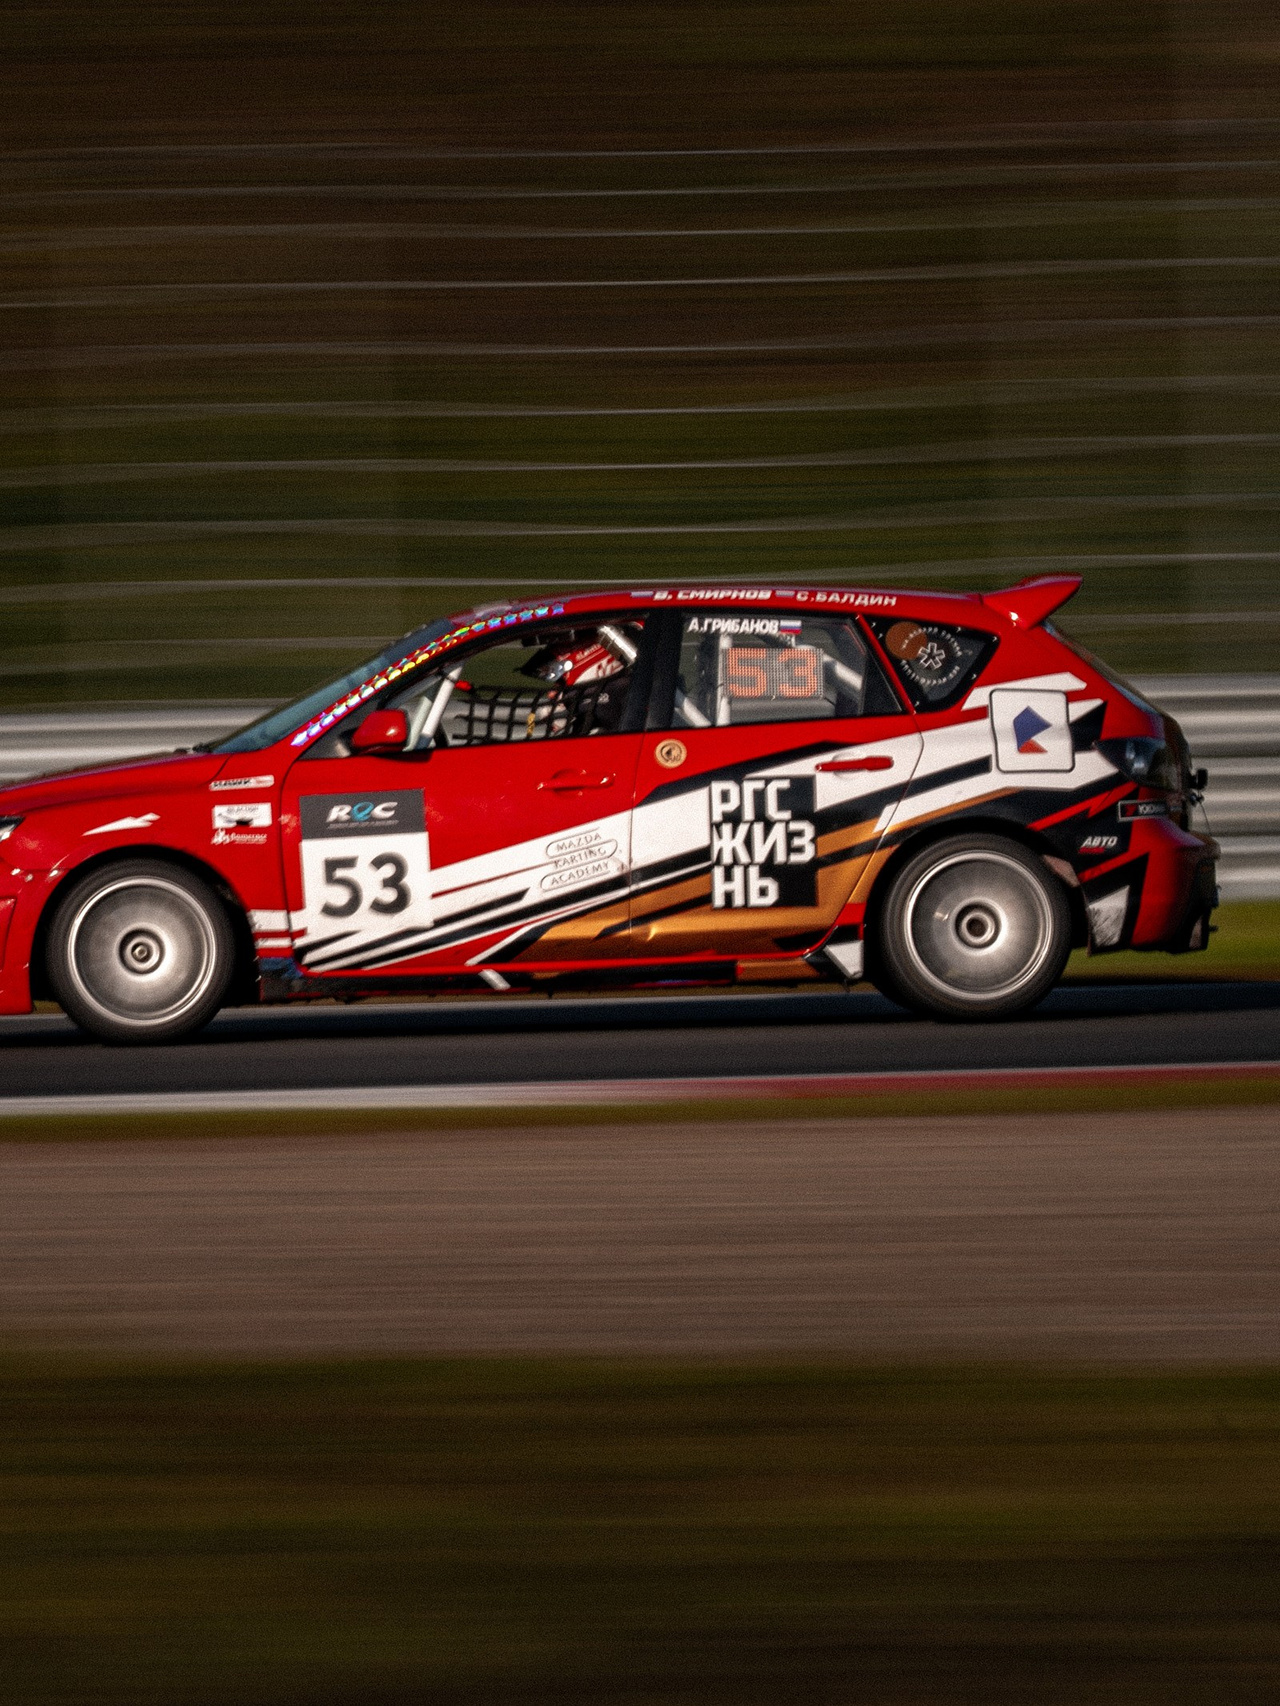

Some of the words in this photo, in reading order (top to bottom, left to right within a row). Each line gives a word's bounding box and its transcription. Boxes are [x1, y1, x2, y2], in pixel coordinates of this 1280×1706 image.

[676, 589, 773, 601] СМИРНОВ
[687, 616, 780, 635] А.ГРИБАНОВ
[726, 647, 819, 699] 53
[710, 778, 793, 823] РГС
[554, 847, 607, 869] KARTING
[556, 832, 602, 852] MAZDA
[711, 820, 816, 866] ЖИЗ
[321, 851, 412, 918] 53
[551, 861, 609, 885] ACADEMY
[711, 864, 780, 909] НЬ
